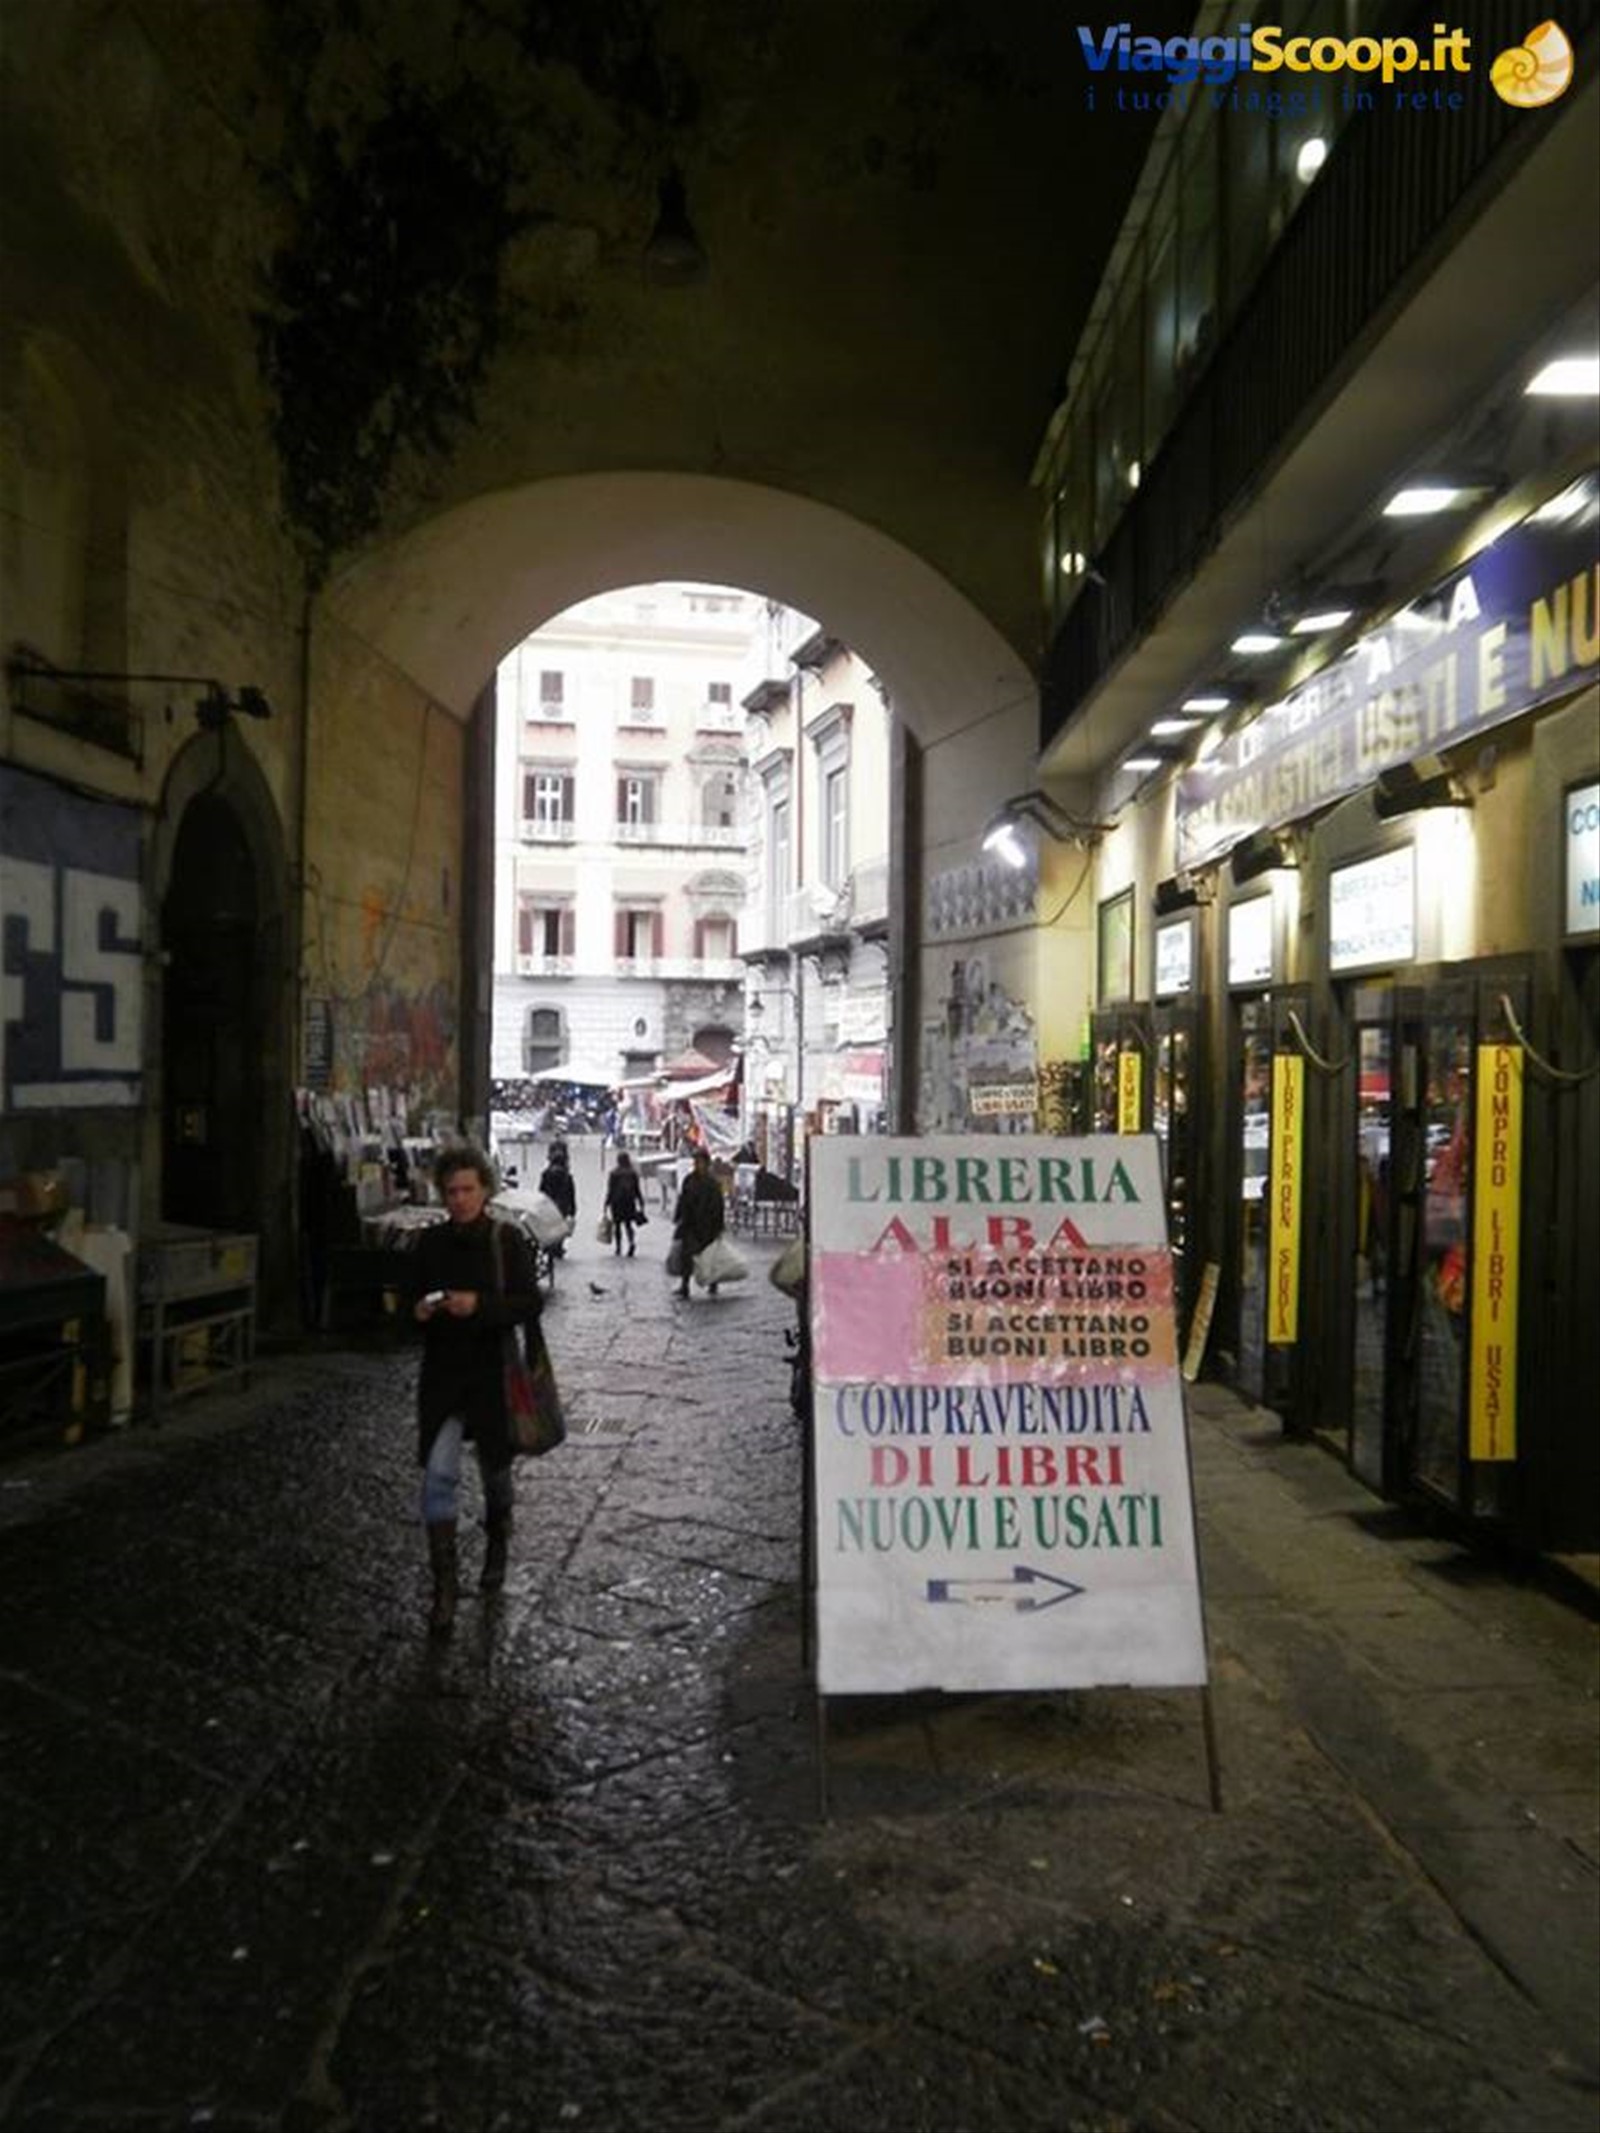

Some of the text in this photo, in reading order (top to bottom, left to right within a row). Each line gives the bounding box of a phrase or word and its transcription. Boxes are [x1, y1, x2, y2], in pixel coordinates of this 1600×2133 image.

[1478, 621, 1506, 717] E
[847, 1157, 1141, 1203] LIBRERIA
[870, 1214, 1092, 1253] ALBA
[1485, 1046, 1509, 1458] COMPRO LIBRI USATI
[947, 1257, 1146, 1276] SI ACCETTANO
[949, 1280, 1147, 1299] BUONI LIBRO
[947, 1314, 1149, 1334] SI ACCETTANO
[948, 1337, 1151, 1357] BUONI LIBRO
[836, 1383, 1151, 1436] COMPRAVENDITA
[870, 1445, 1124, 1487] DI LIBRI
[837, 1493, 1162, 1552] NUOVI E USATI
